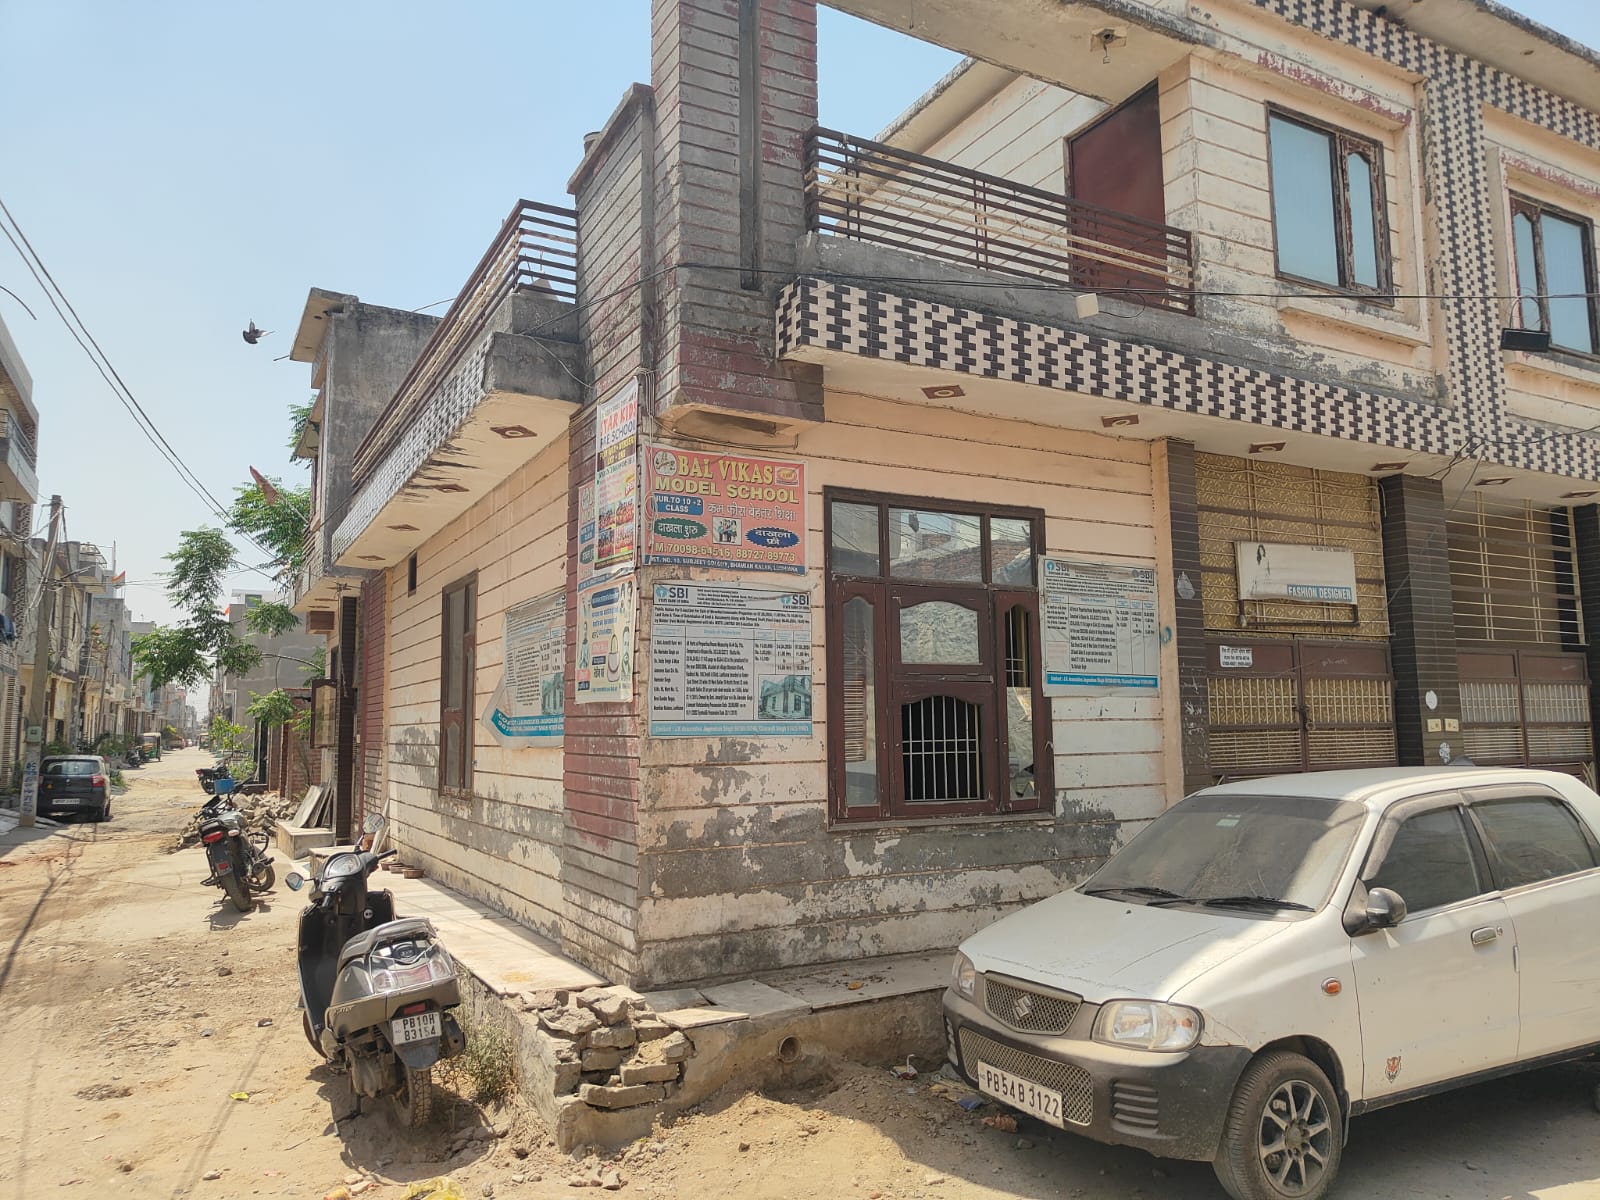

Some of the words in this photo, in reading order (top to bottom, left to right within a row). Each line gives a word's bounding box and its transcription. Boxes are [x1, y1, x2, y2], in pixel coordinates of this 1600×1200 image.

[677, 455, 713, 479] BAL
[718, 459, 773, 485] VIKAS
[655, 476, 721, 496] MODEL
[726, 484, 799, 504] SCHOOL
[665, 504, 689, 512] CLASS
[1055, 562, 1070, 572] SBI
[1140, 570, 1153, 580] SBI
[669, 587, 689, 599] SBI
[1288, 586, 1318, 598] FASHION
[1319, 587, 1352, 600] DESIGNER
[791, 594, 809, 605] SBI
[402, 1013, 435, 1030] PB10H
